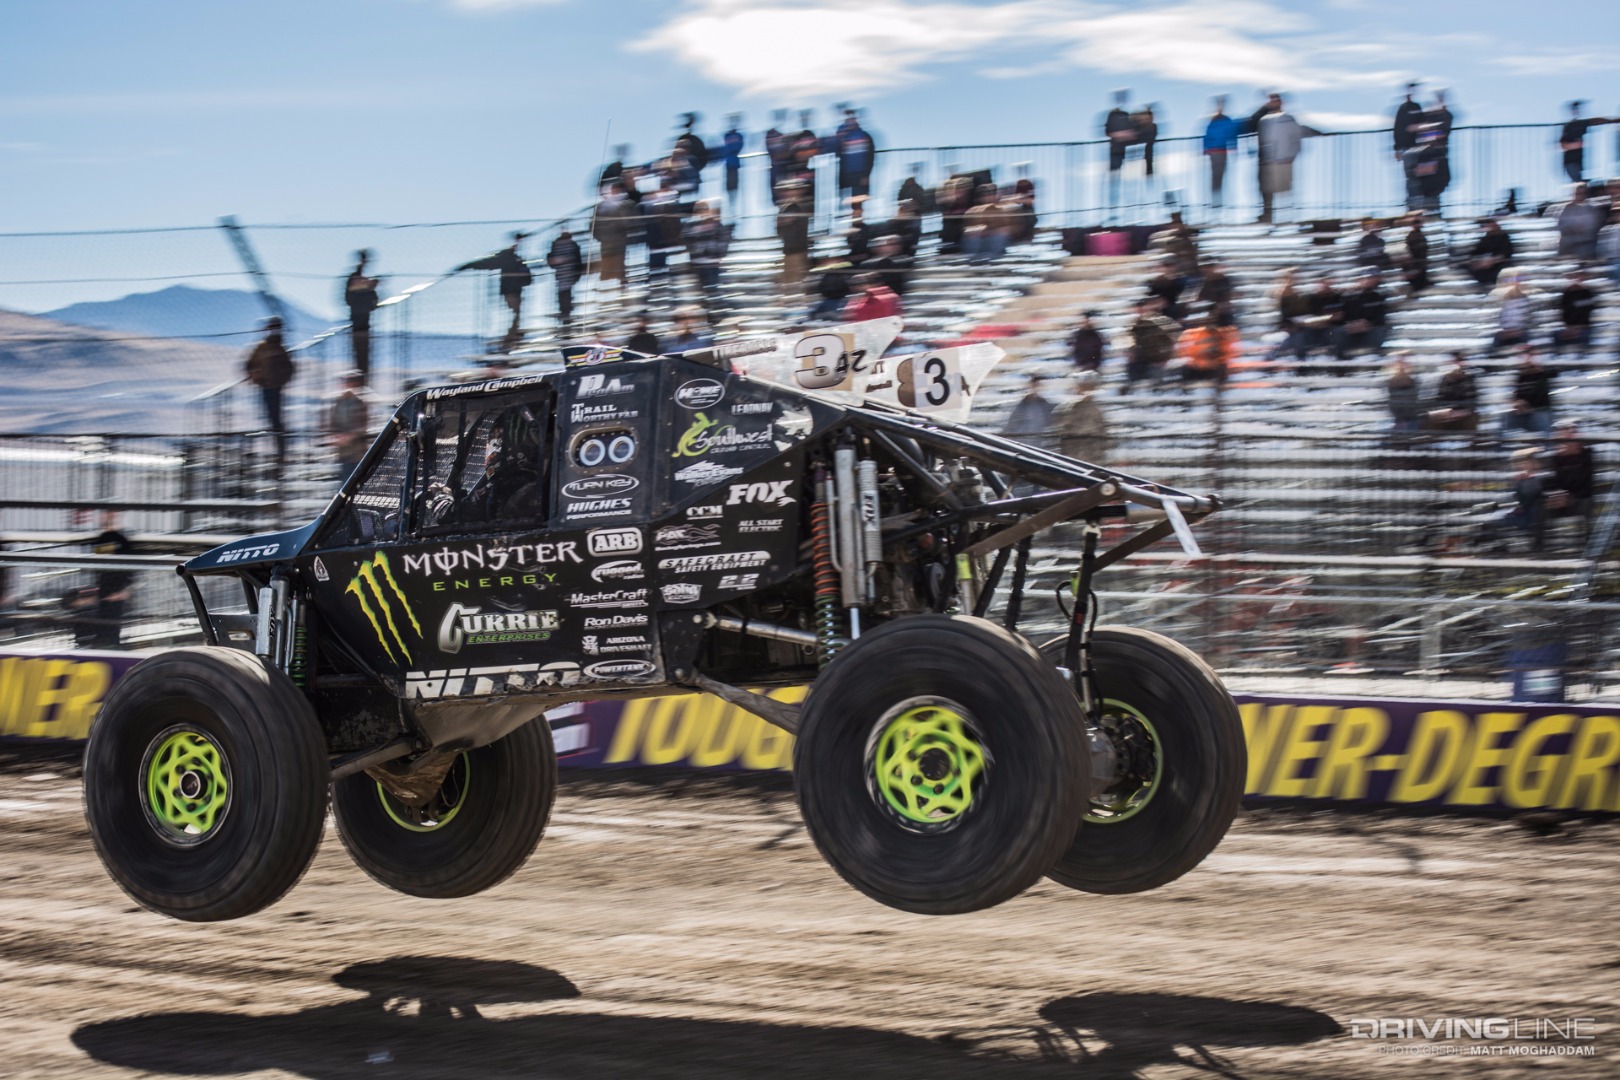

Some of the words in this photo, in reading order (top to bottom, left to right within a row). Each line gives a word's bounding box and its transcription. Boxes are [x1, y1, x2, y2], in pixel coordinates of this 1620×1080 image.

[795, 333, 845, 389] 3
[426, 383, 485, 401] Wayland
[484, 374, 545, 392] Campbell
[923, 357, 951, 406] 3
[726, 480, 797, 507] FOX
[566, 498, 634, 514] HUGHES
[566, 508, 633, 520] PERFORMANCE
[686, 504, 724, 517] CCM
[594, 533, 639, 553] ARB
[215, 543, 281, 564] NITTO
[403, 541, 585, 578] MONSTER
[664, 552, 758, 569] SAFECRAFT
[674, 565, 709, 574] SAFETY
[711, 559, 767, 570] EQUIPMENT
[432, 572, 558, 592] ENERGY
[570, 588, 649, 604] MasterCraft
[438, 601, 560, 655] CURRIE
[584, 616, 612, 628] Ron
[613, 613, 649, 625] Davis
[468, 631, 552, 644] ENTERPRISES
[606, 635, 646, 645] ARIZONA
